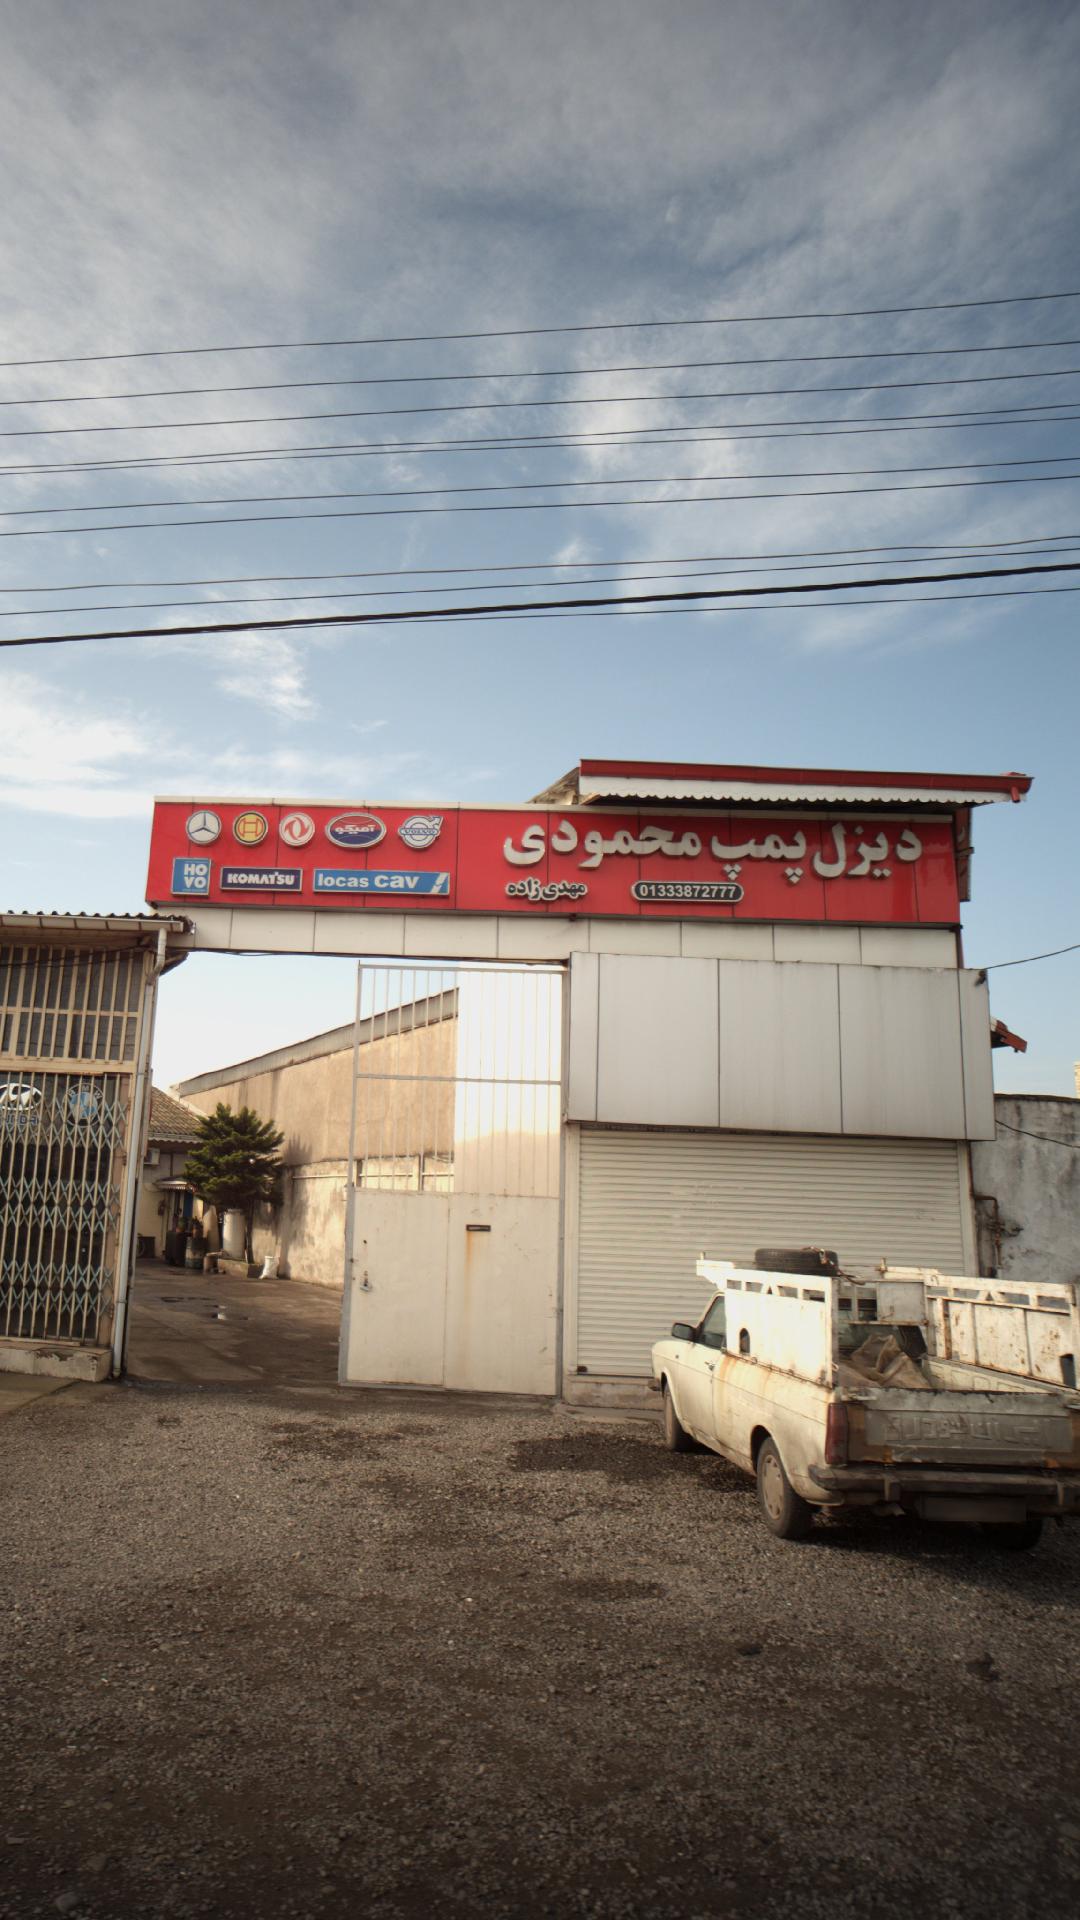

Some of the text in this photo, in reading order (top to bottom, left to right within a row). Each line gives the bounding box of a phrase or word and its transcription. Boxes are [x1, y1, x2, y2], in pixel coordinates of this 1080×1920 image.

[503, 819, 702, 869] محمودی
[711, 831, 807, 884] پمپ
[813, 822, 923, 878] دیزل
[227, 871, 295, 886] KOMATSU
[317, 873, 420, 889] locas cav
[639, 884, 737, 899] 01333872777
